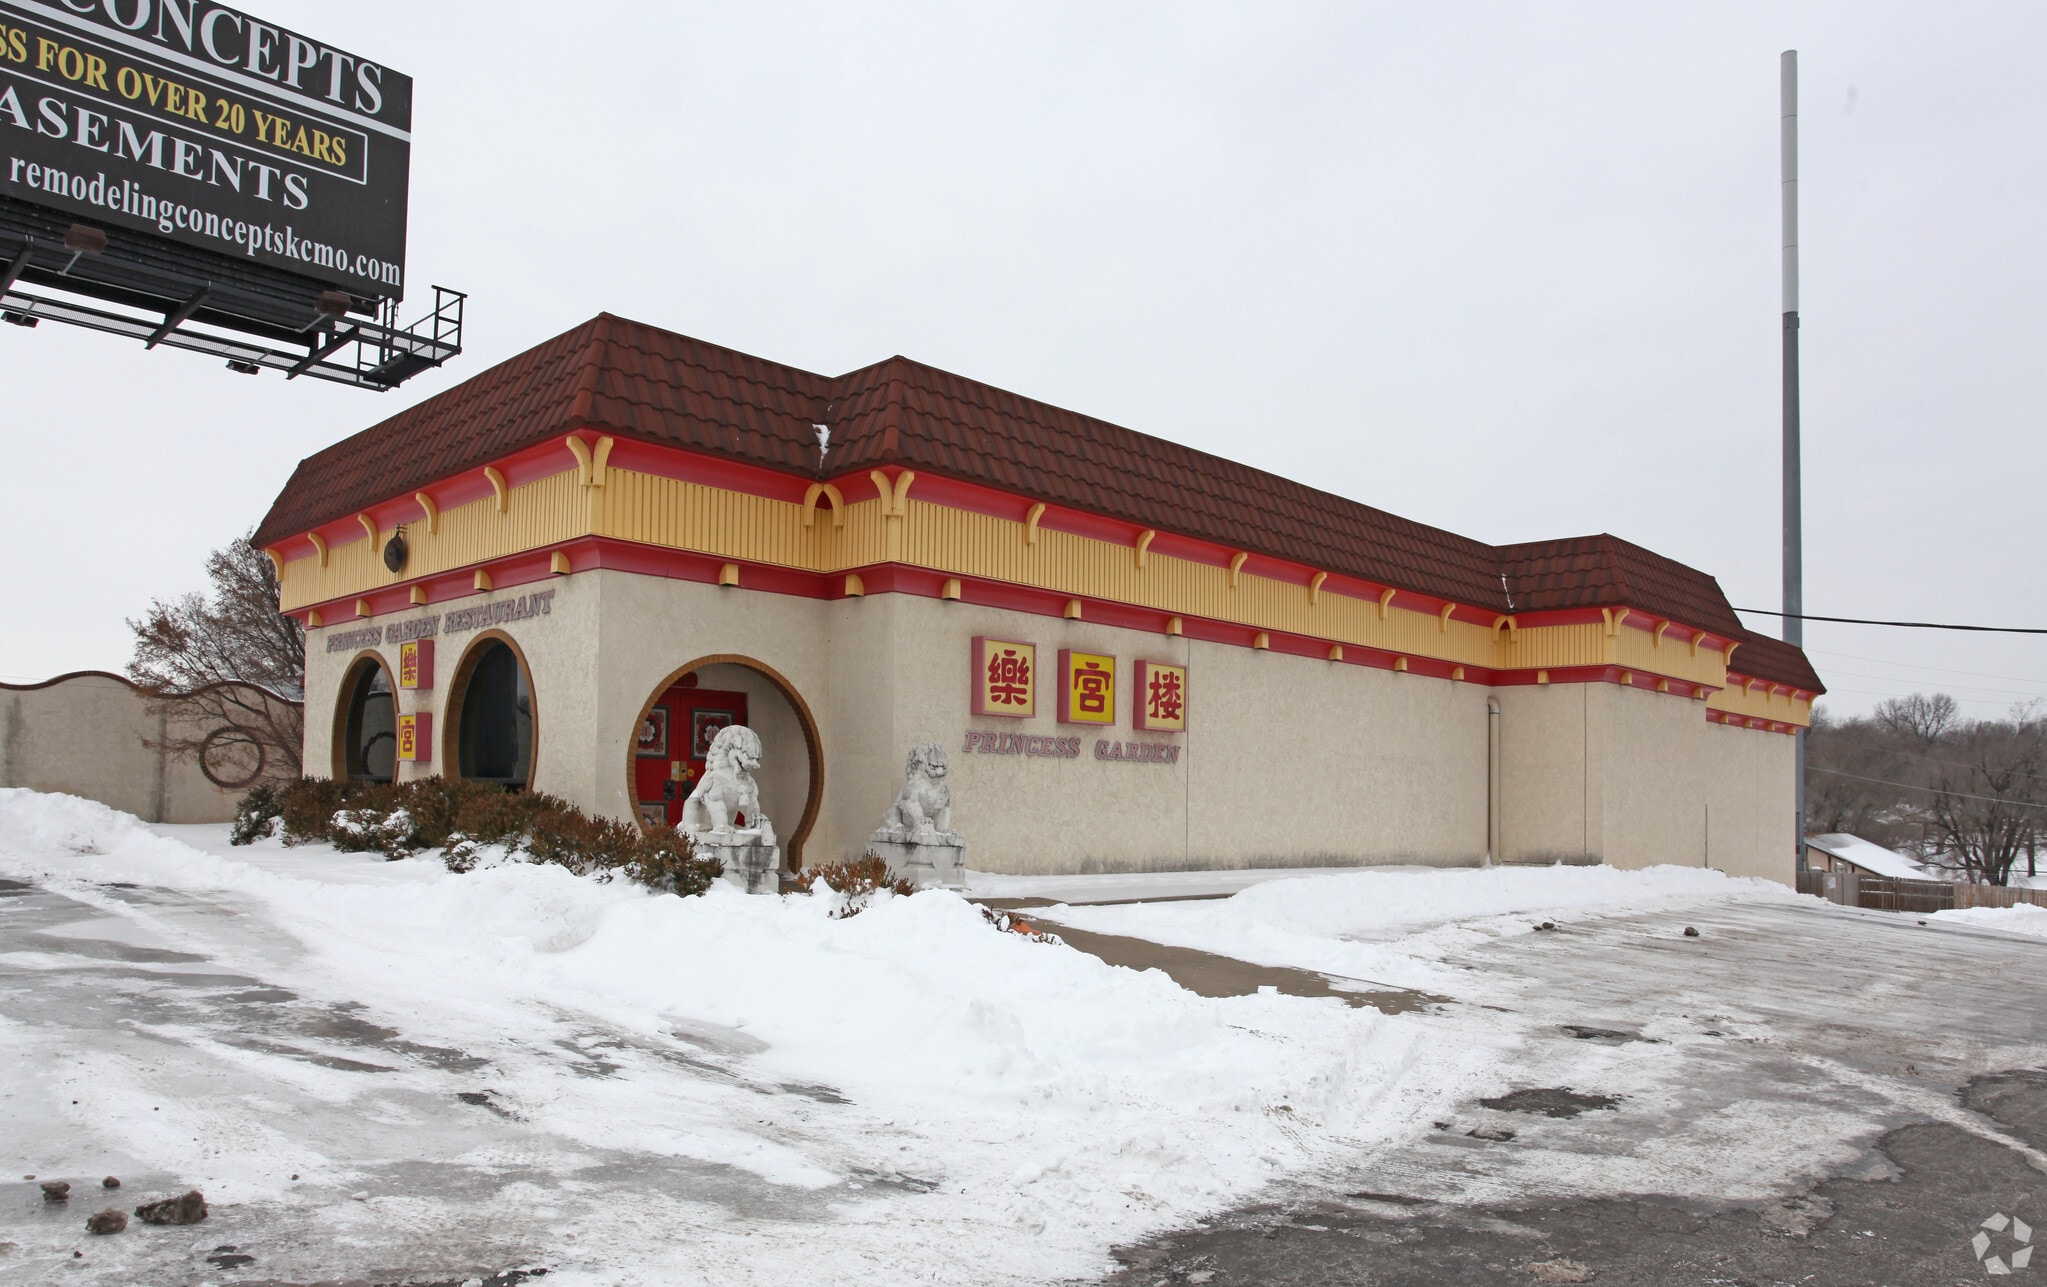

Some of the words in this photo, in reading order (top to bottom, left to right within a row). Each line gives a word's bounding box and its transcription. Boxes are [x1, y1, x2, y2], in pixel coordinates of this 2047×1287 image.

[35, 36, 109, 91] FOR
[116, 66, 209, 124] OVER
[215, 98, 245, 134] 20
[252, 109, 346, 166] YEARS
[60, 0, 383, 115] ONCEPTS
[0, 85, 309, 210] ASEMENTS
[9, 156, 400, 286] remodelingconceptskcmo.com
[326, 627, 383, 653] PRINCESS
[385, 615, 440, 644] GARDEN
[443, 590, 555, 633] RESTAURANT
[963, 731, 1081, 758] PRINCESS
[1094, 739, 1181, 764] GARDEN
